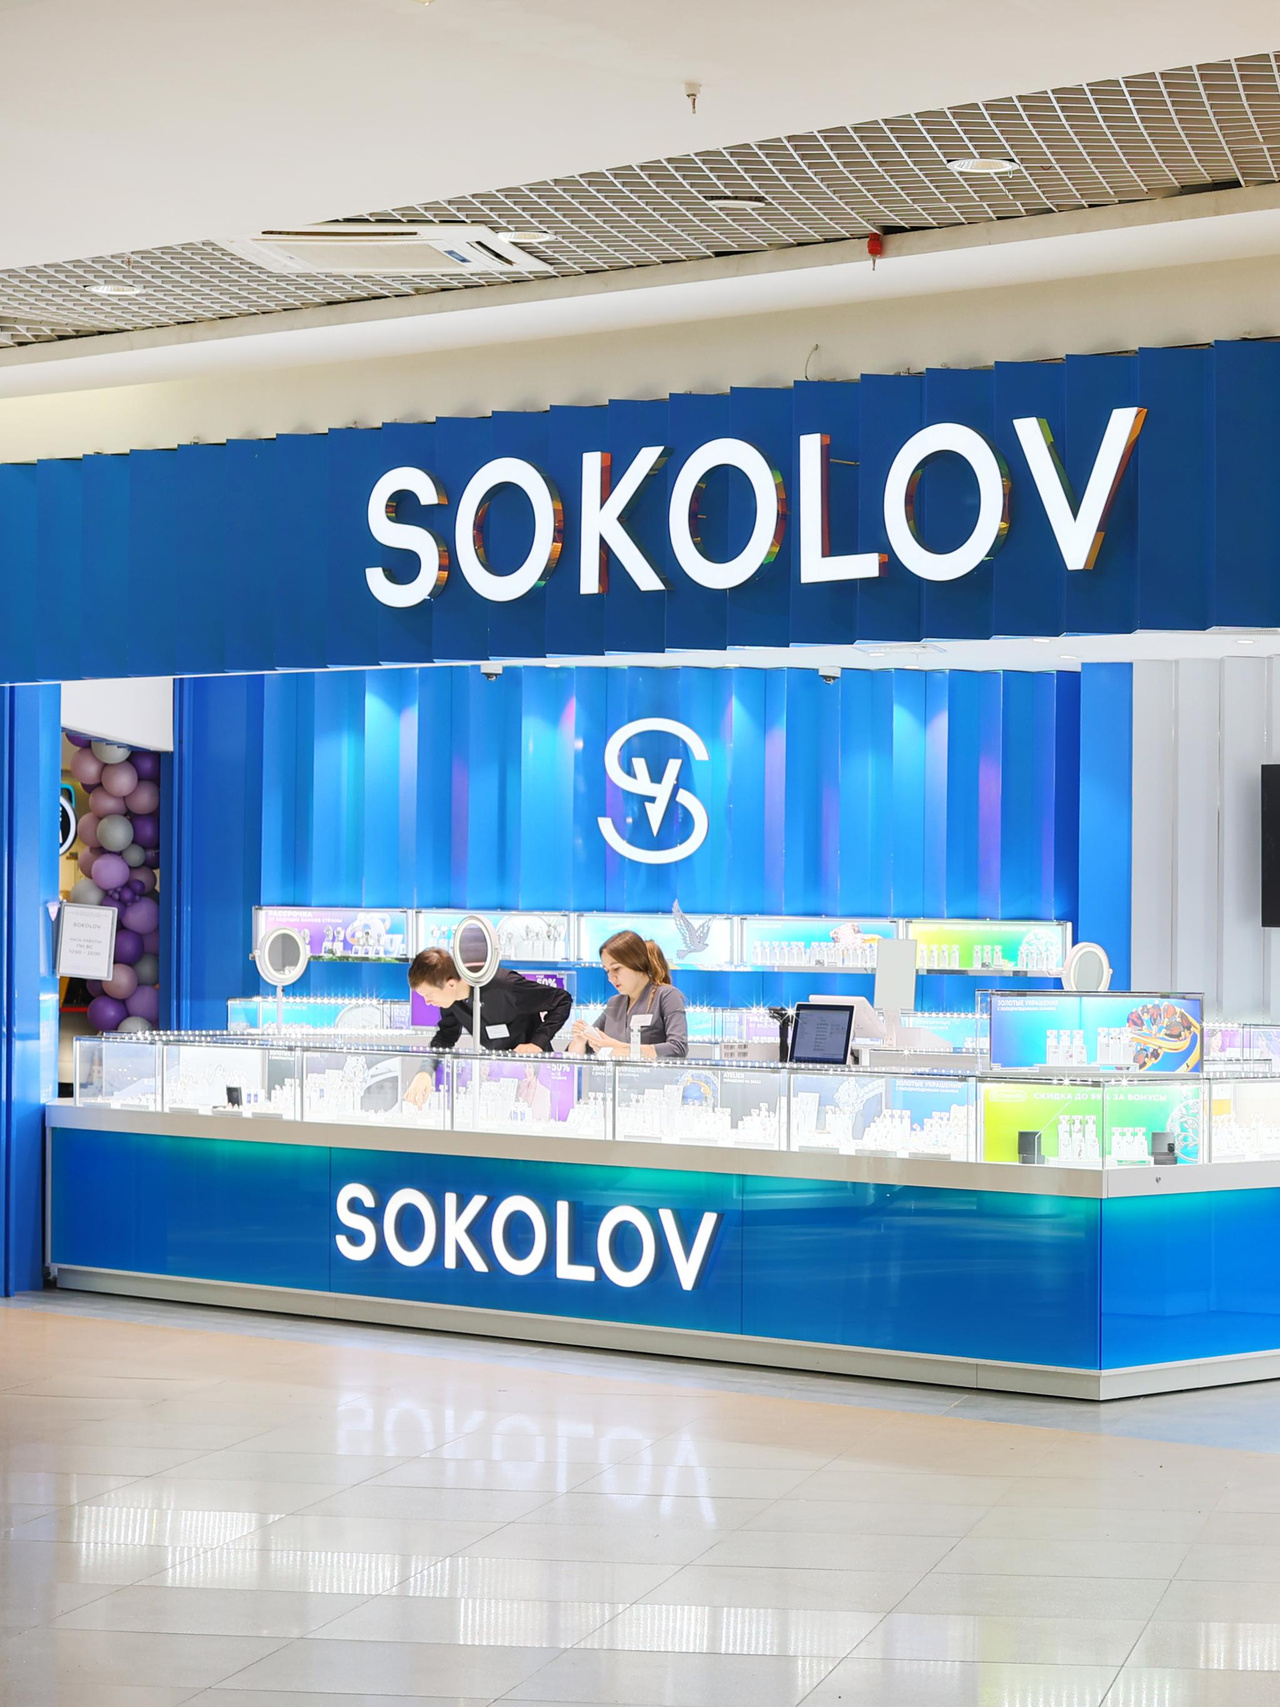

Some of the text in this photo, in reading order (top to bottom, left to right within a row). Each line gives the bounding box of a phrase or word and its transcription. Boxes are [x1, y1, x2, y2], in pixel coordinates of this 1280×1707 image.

[365, 406, 1145, 609] SOKOLOV
[1034, 1092, 1072, 1101] СКИДКА
[1074, 1092, 1089, 1101] ДО
[1113, 1093, 1125, 1101] ЗА
[1127, 1094, 1167, 1102] БОНУСЫ
[335, 1182, 718, 1291] SOKOLOV
